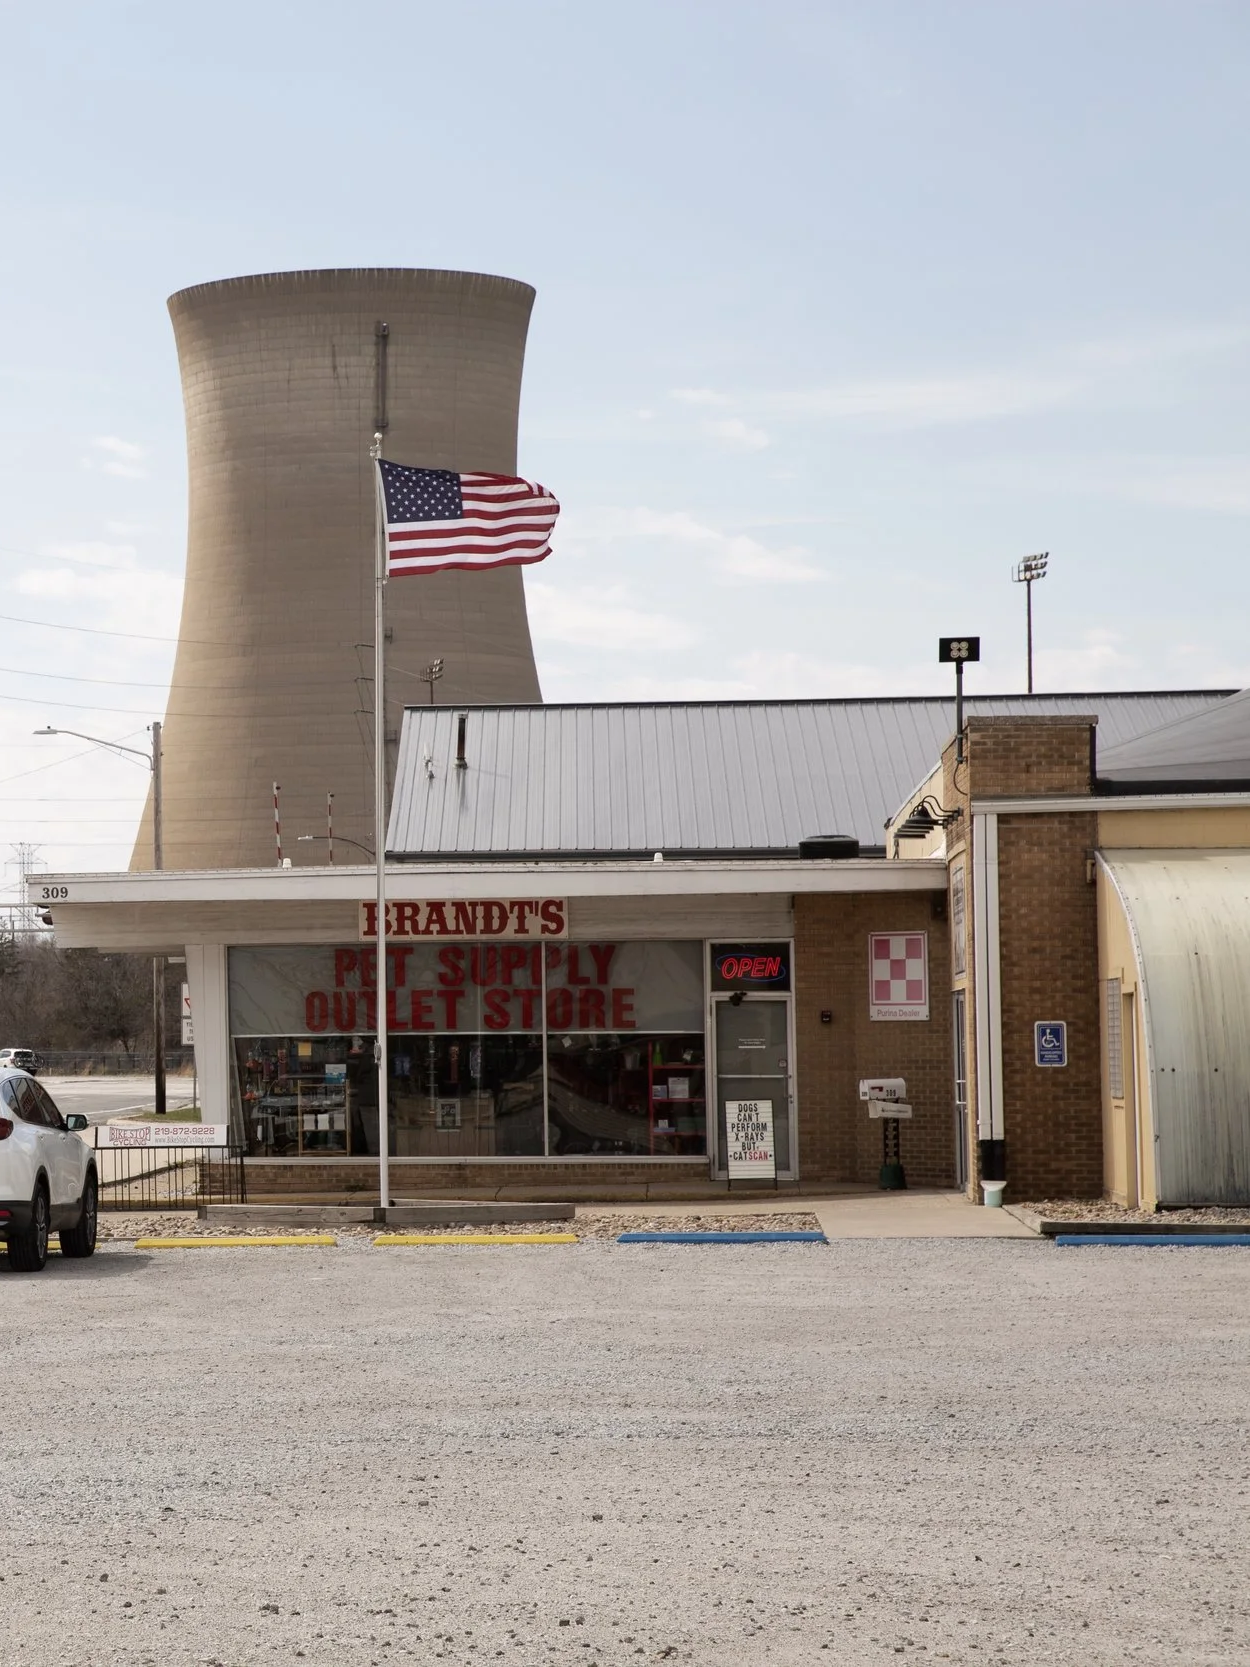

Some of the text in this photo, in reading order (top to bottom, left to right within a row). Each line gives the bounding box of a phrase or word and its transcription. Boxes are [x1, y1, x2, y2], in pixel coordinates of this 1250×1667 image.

[41, 886, 69, 899] 309
[362, 899, 565, 937] BRANDT'S
[334, 943, 617, 988] PET SUPPLY
[721, 956, 781, 979] OPEN
[305, 987, 637, 1033] OUTLET STORE
[738, 1103, 758, 1113] DOGS
[737, 1112, 759, 1122] CAN'T
[109, 1126, 129, 1141] BIKE
[130, 1125, 151, 1141] STOP
[731, 1122, 768, 1132] PERFORM
[734, 1131, 765, 1141] X-RAYS
